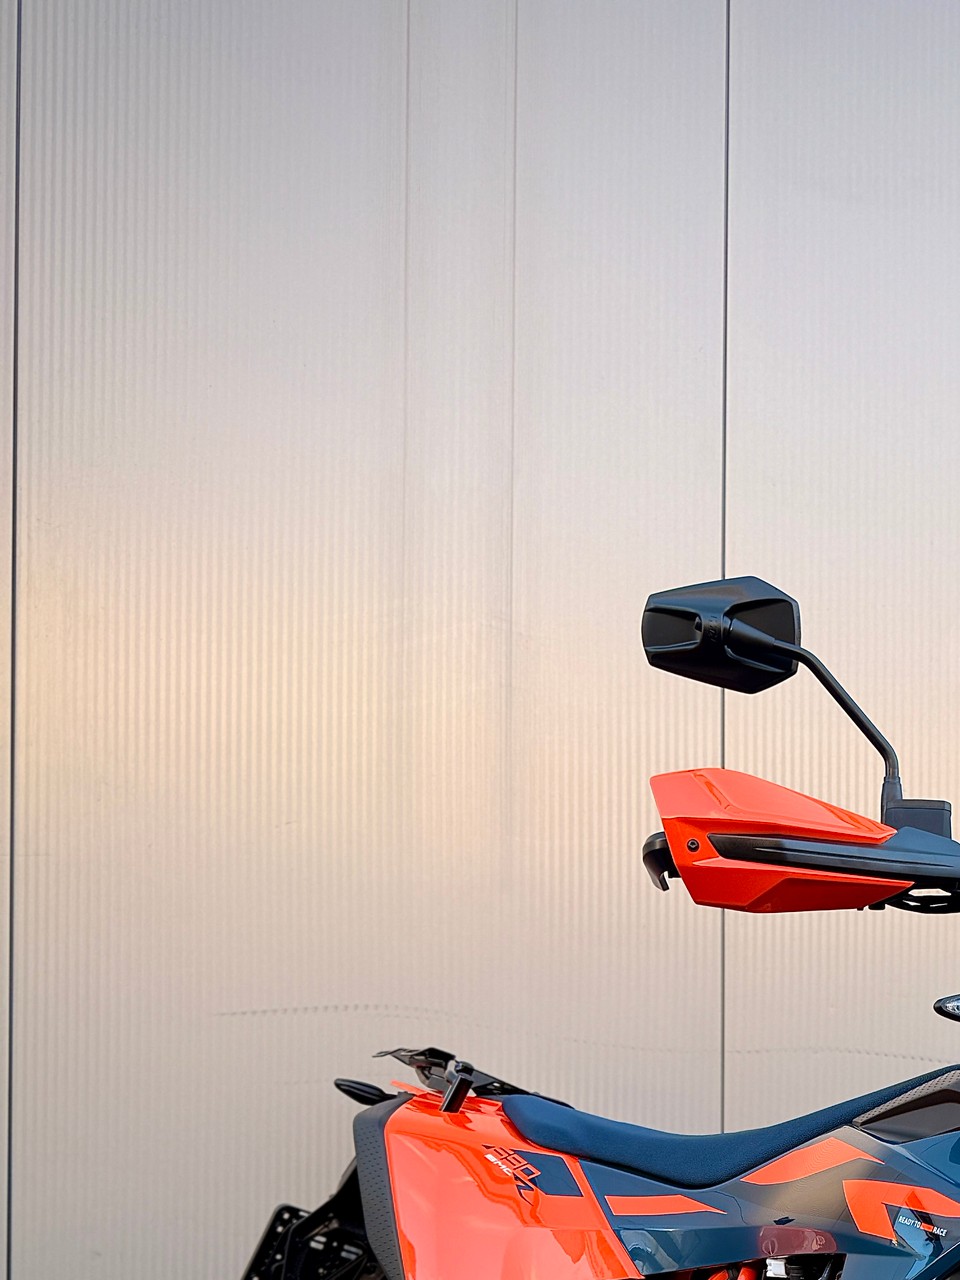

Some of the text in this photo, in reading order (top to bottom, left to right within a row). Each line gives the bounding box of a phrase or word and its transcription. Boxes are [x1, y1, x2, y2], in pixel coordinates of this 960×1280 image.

[898, 1215, 948, 1237] READY TO RACE
